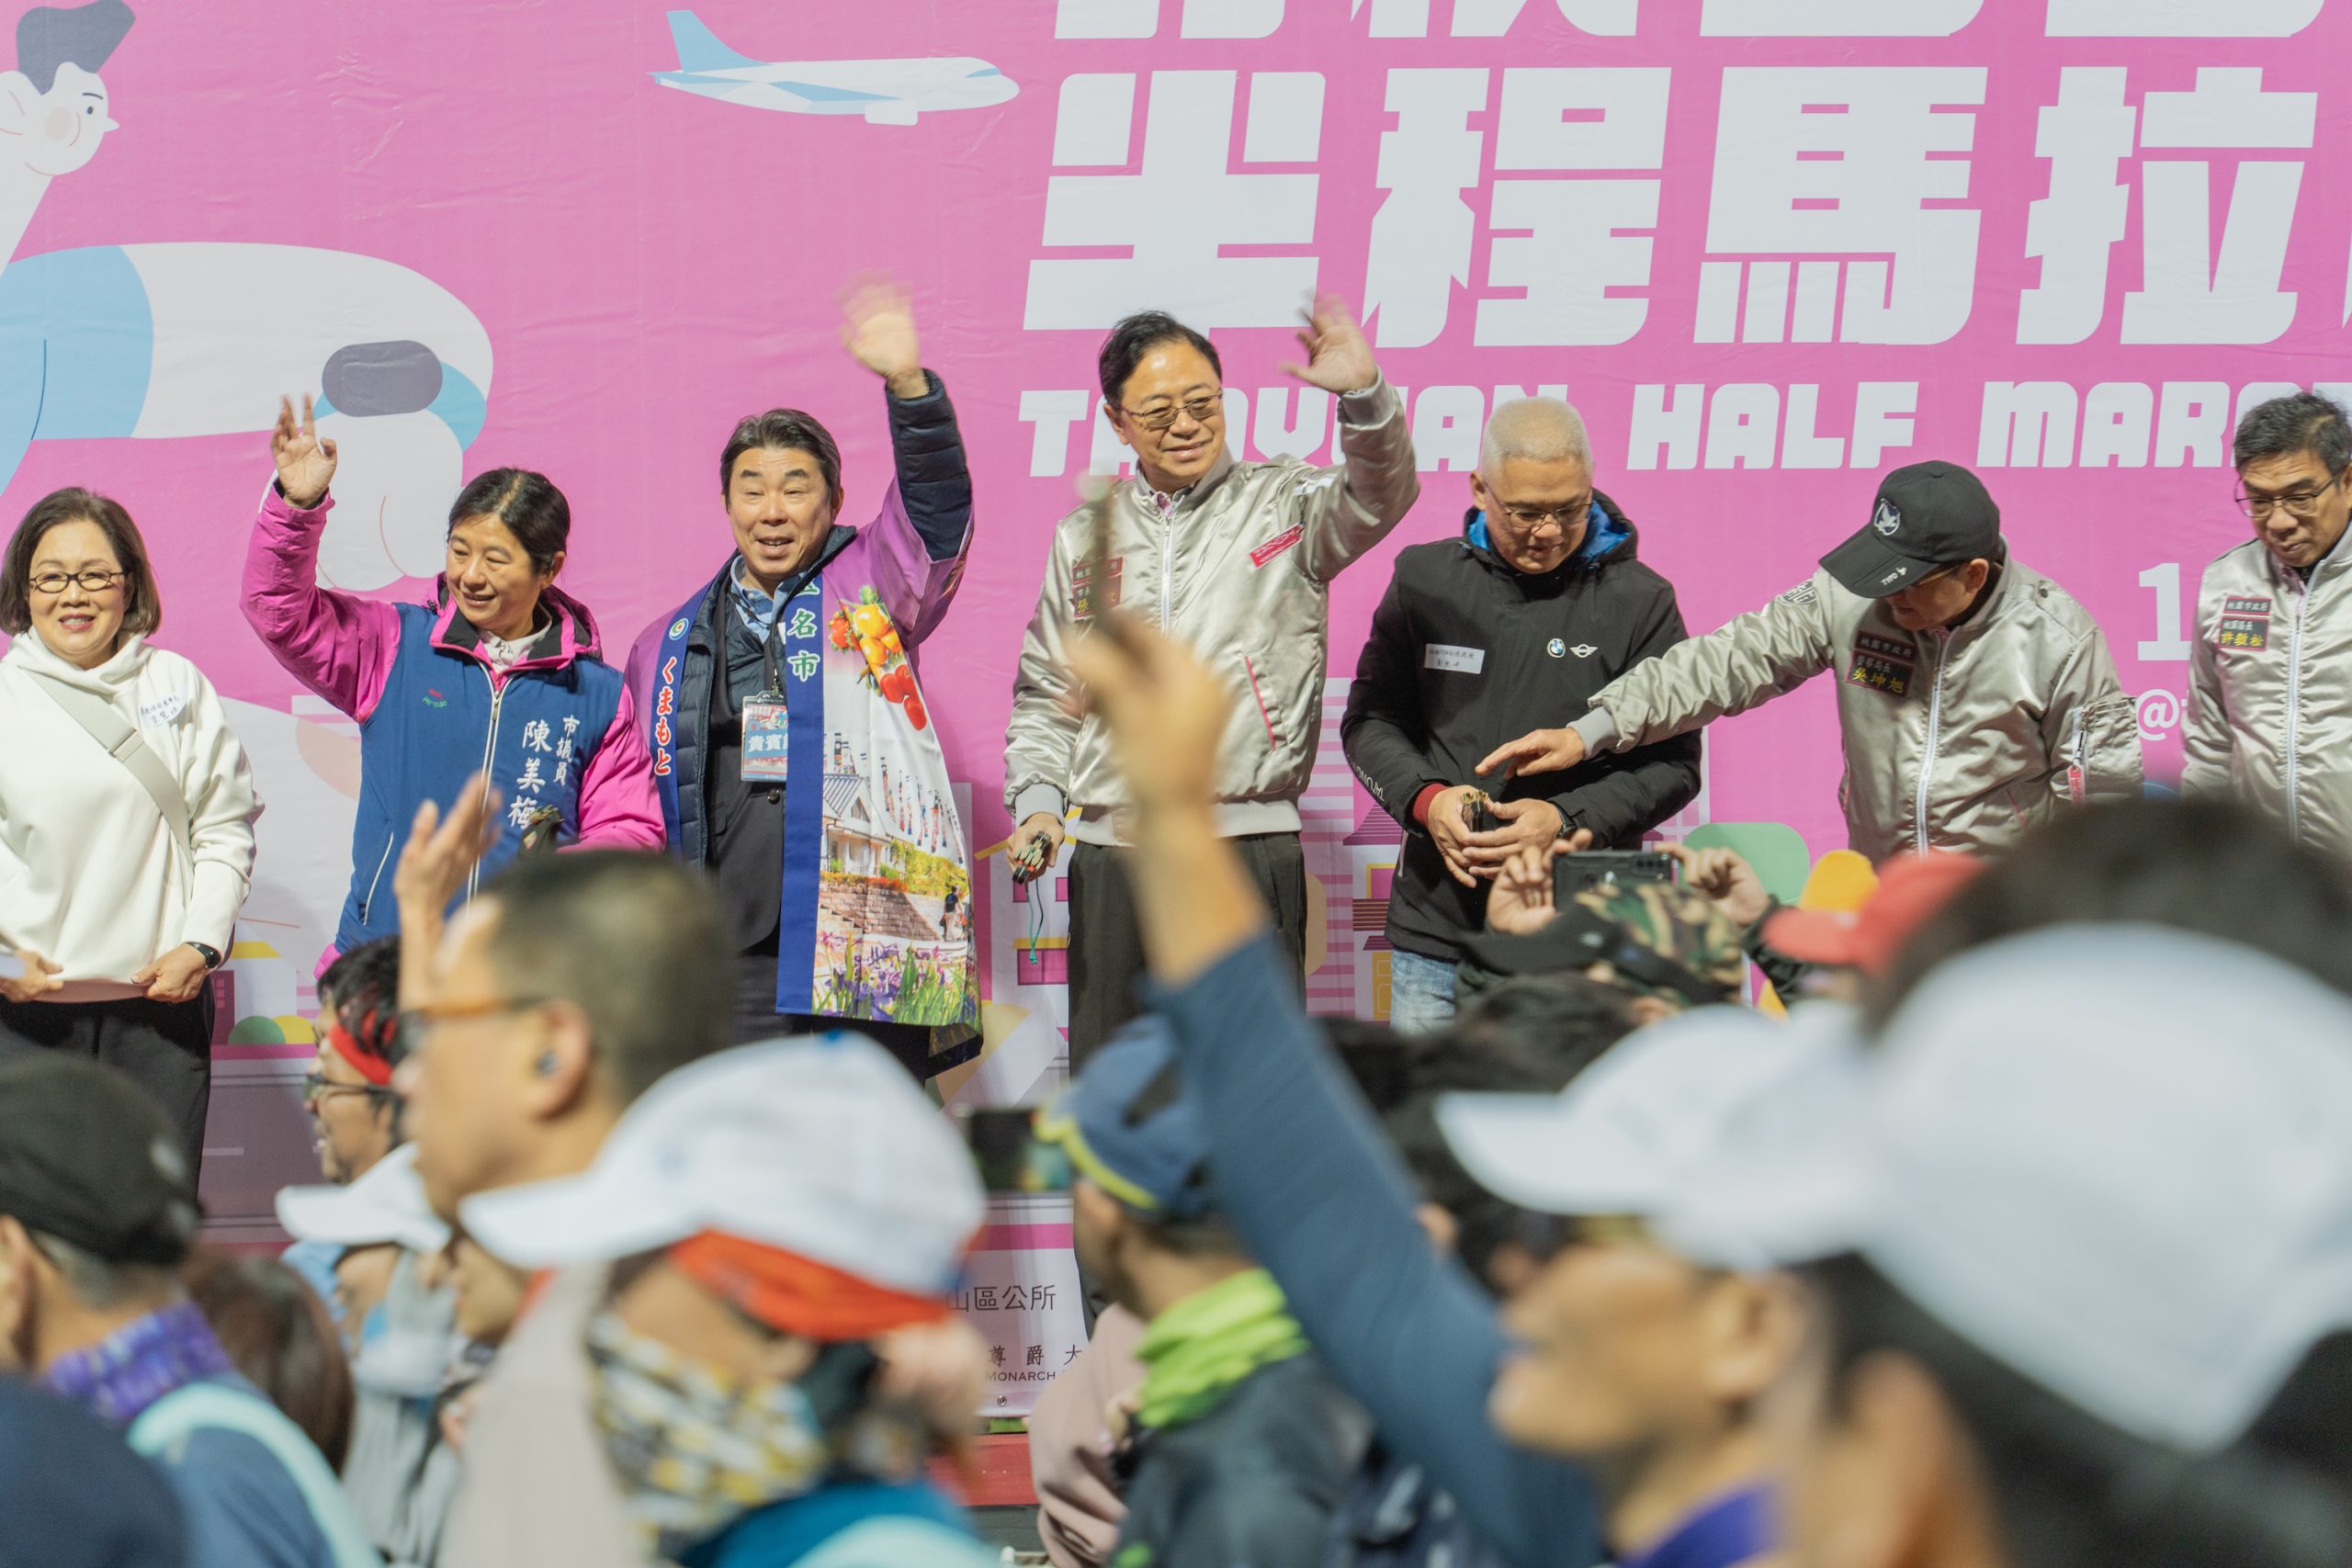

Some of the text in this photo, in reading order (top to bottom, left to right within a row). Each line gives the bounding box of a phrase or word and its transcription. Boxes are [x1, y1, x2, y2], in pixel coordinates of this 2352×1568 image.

[1023, 66, 2352, 348] 半程馬拉
[1626, 382, 1920, 470] HALF
[1975, 380, 2352, 468] MAR
[553, 715, 581, 786] 市議員
[654, 656, 678, 776] くまもと
[507, 719, 553, 829] 陳美梅
[985, 1371, 1057, 1382] MONARCH
